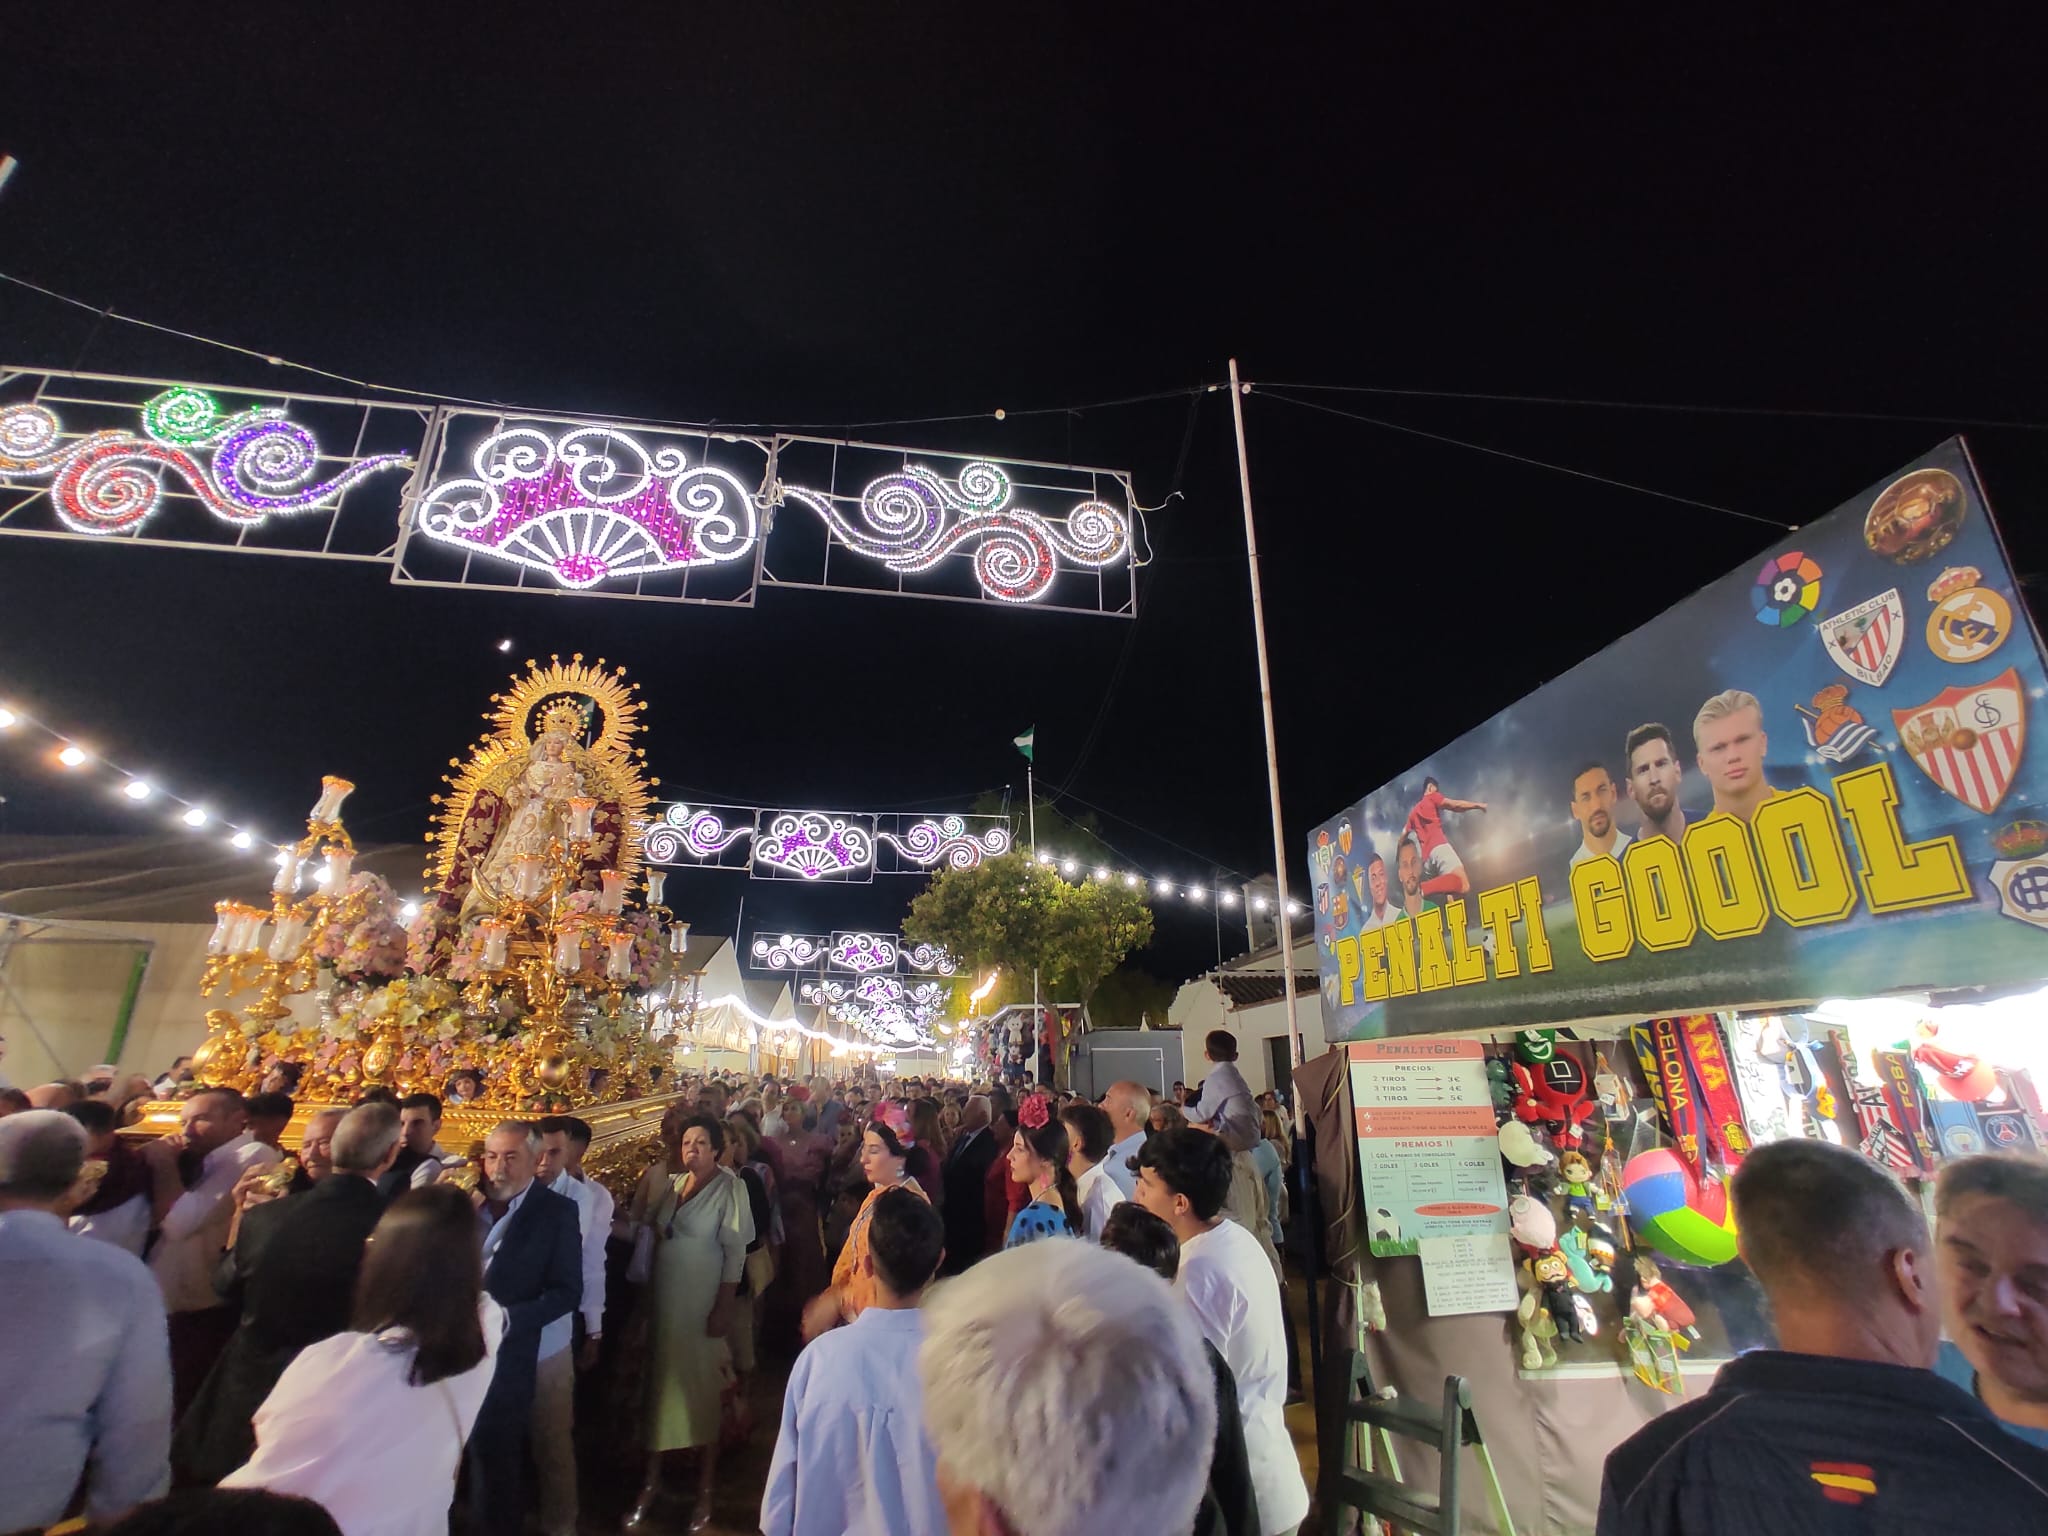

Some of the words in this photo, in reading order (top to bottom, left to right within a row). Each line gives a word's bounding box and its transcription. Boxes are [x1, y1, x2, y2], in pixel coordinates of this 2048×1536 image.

[1822, 608, 1866, 631] ATHLETIC
[1868, 591, 1896, 609] CLUB
[1856, 654, 1893, 683] BILBAO
[1337, 875, 1554, 1007] PENALTI
[1569, 761, 1973, 963] GOOOL
[1656, 1018, 1688, 1112] CELONA
[1395, 1141, 1443, 1149] PREMIOS
